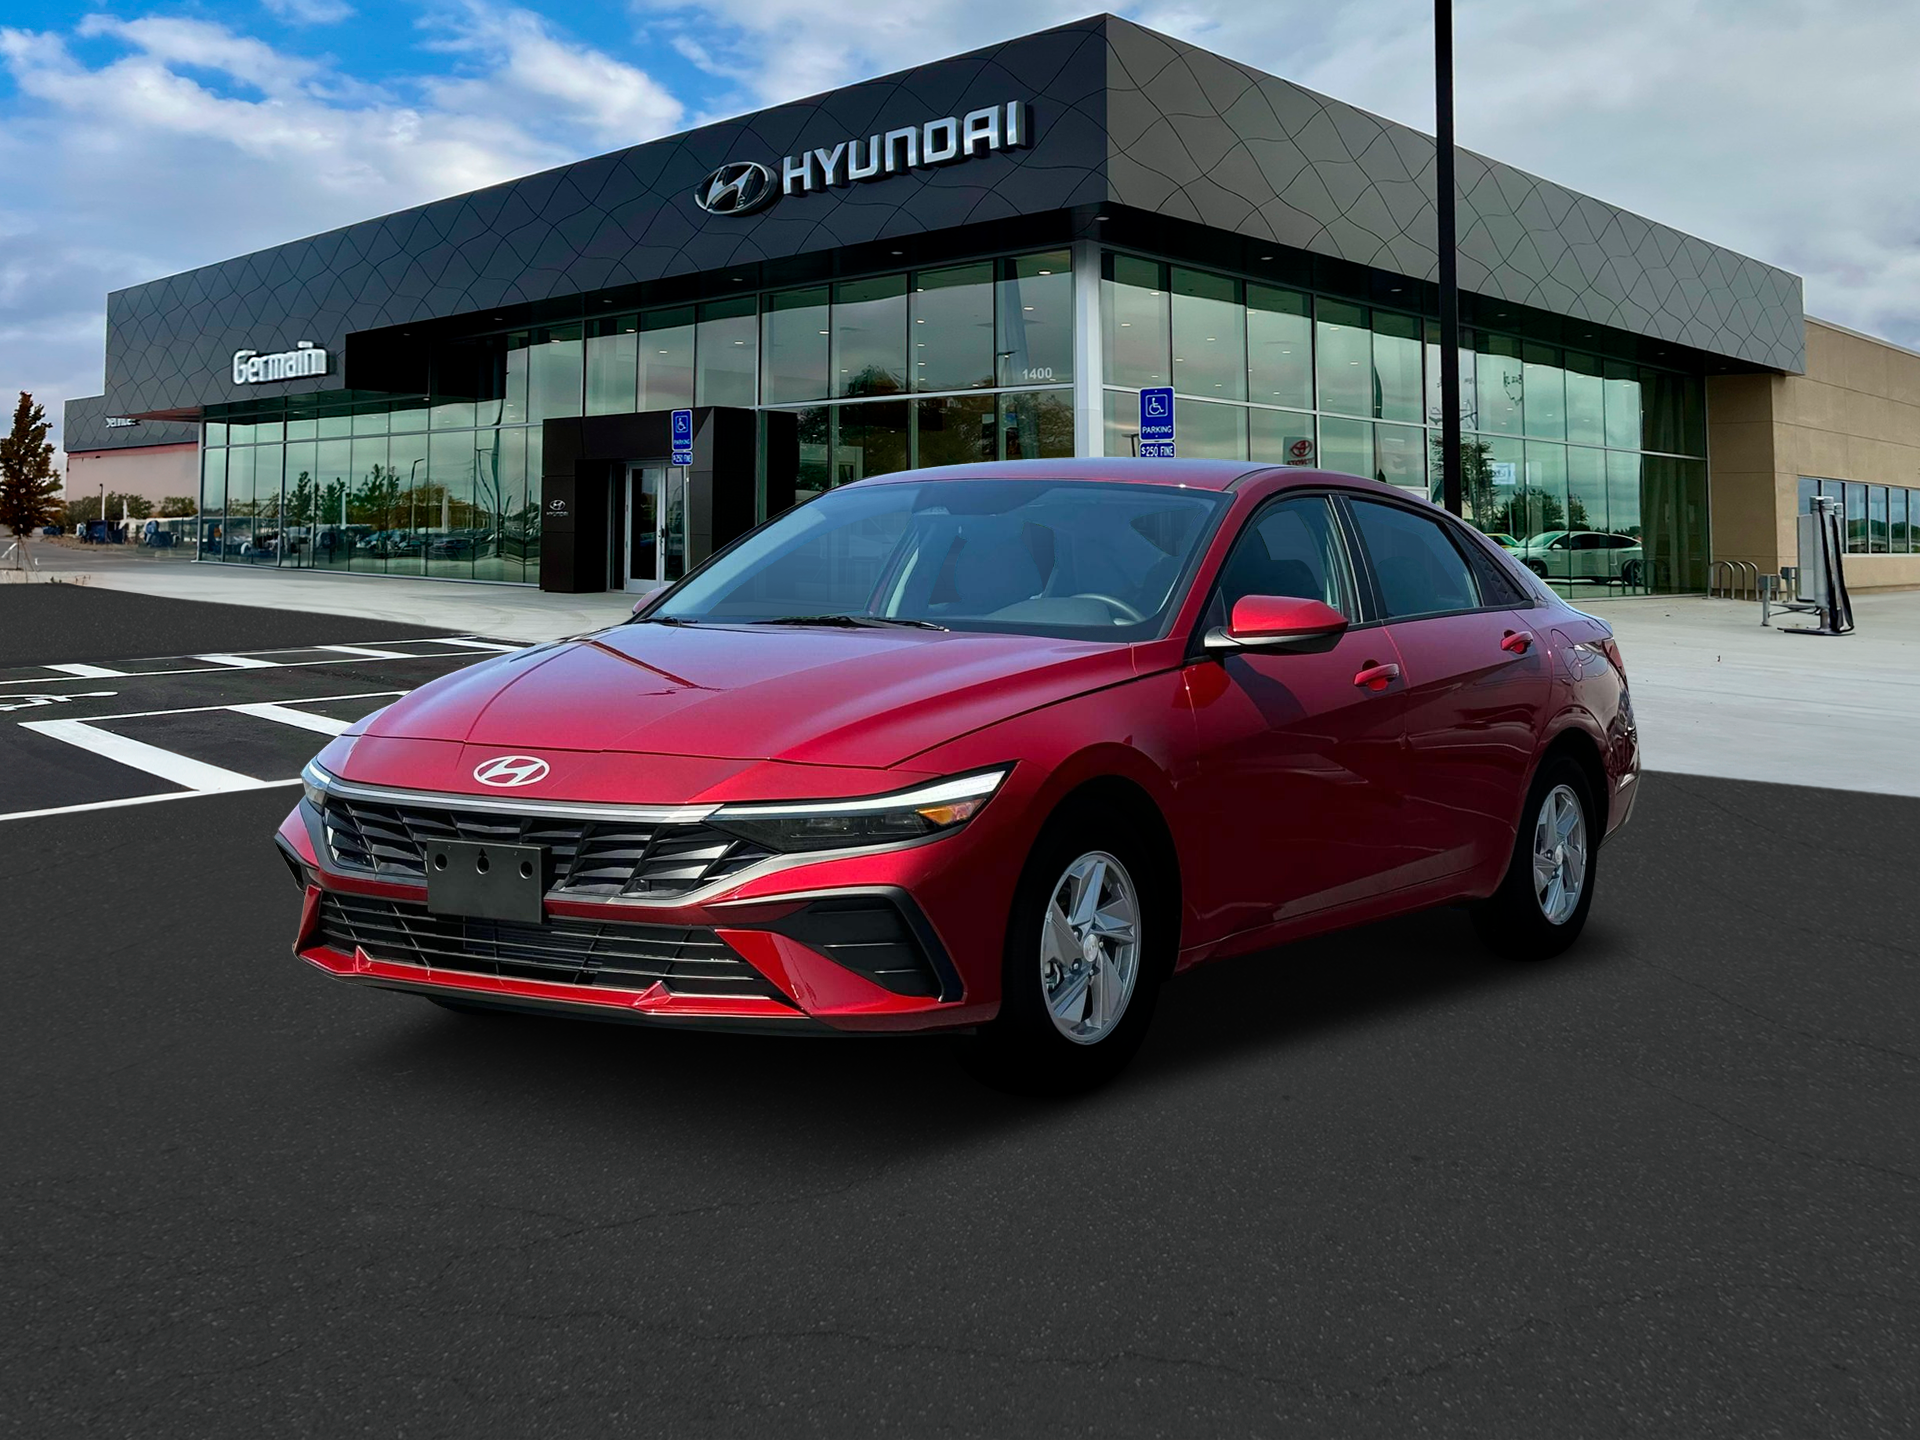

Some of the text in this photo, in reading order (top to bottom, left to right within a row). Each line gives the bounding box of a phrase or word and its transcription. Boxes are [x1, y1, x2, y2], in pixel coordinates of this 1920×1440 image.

[783, 100, 1024, 196] HYUNDAI
[233, 340, 327, 385] Germain
[1022, 367, 1052, 380] 1400
[1142, 425, 1172, 434] PARKING
[1160, 445, 1174, 457] FINE
